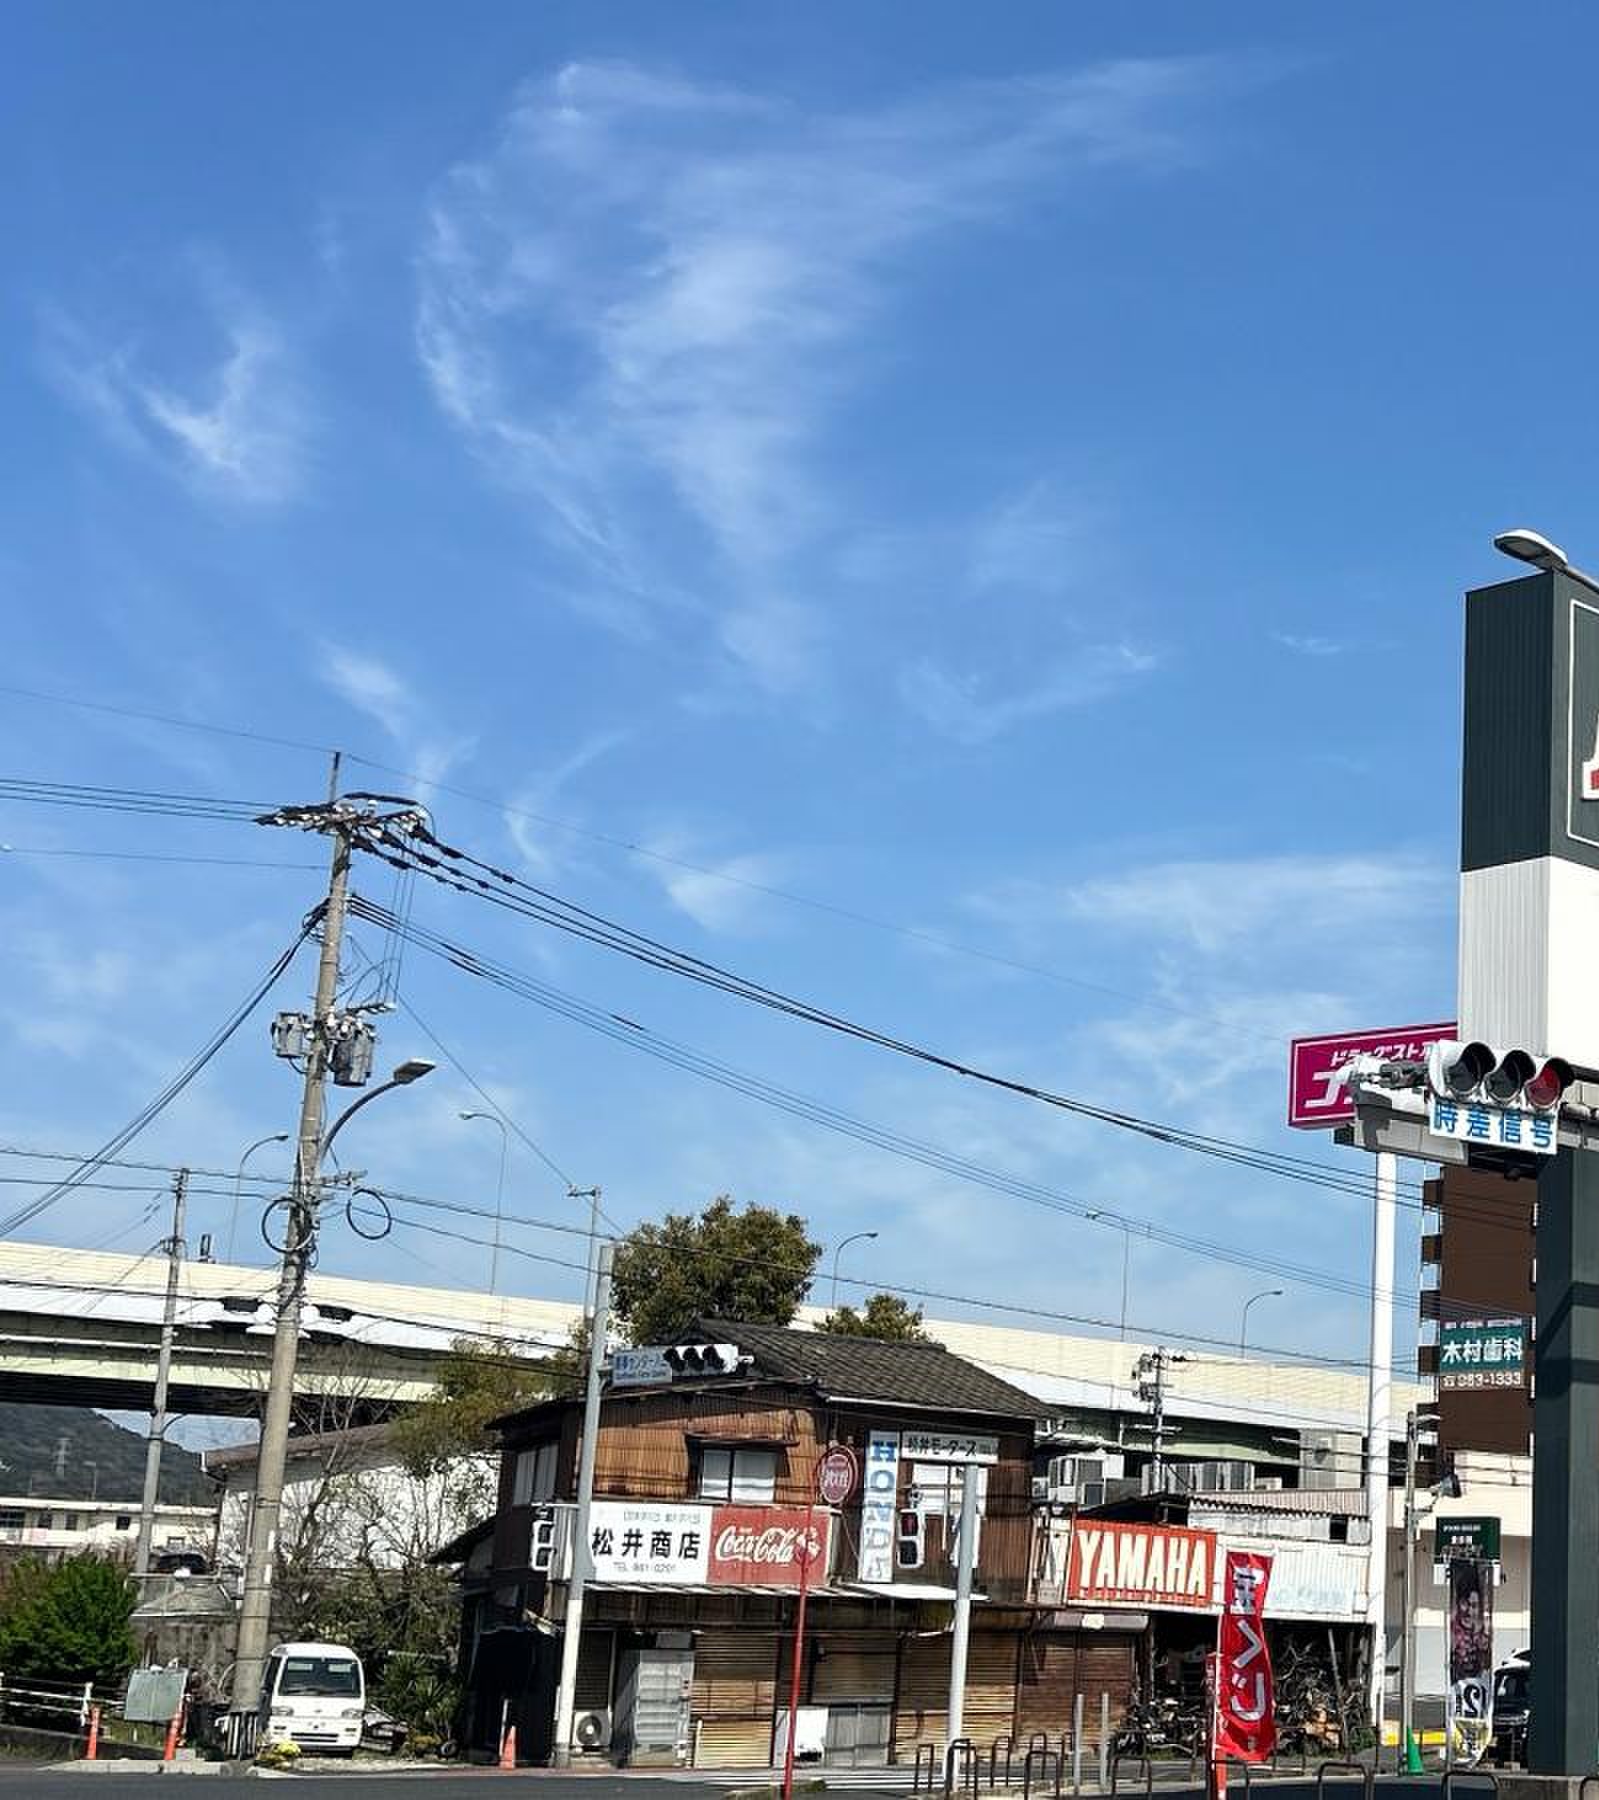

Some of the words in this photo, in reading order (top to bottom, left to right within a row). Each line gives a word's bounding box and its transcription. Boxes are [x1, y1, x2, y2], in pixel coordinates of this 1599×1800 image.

[1434, 1098, 1555, 1149] 時差信号
[1441, 1337, 1523, 1364] 木村歯科
[591, 1526, 701, 1561] 松井商店
[715, 1525, 799, 1566] Coca-Cola
[1077, 1529, 1208, 1598] YAMAHA
